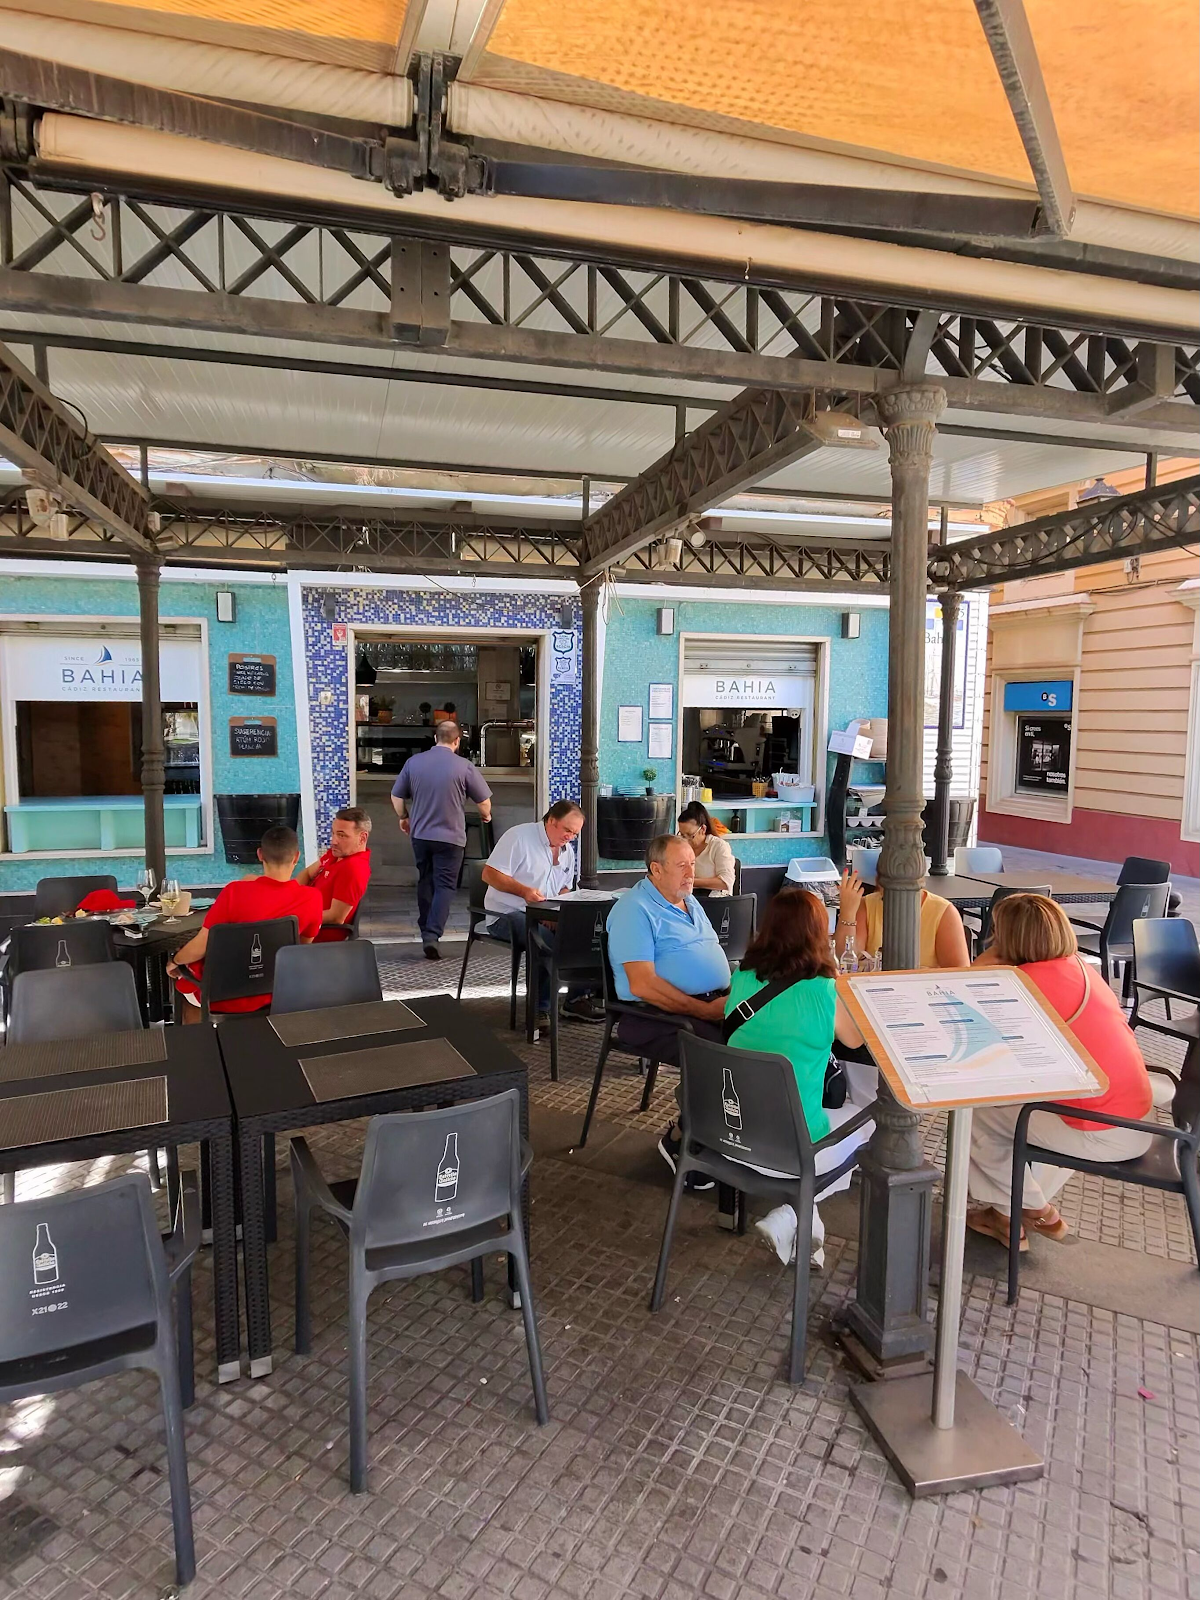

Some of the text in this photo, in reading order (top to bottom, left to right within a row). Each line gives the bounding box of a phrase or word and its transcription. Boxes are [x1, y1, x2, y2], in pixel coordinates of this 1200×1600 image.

[925, 632, 943, 644] Bah
[62, 669, 142, 684] BAHIA
[716, 680, 776, 693] BAHIA
